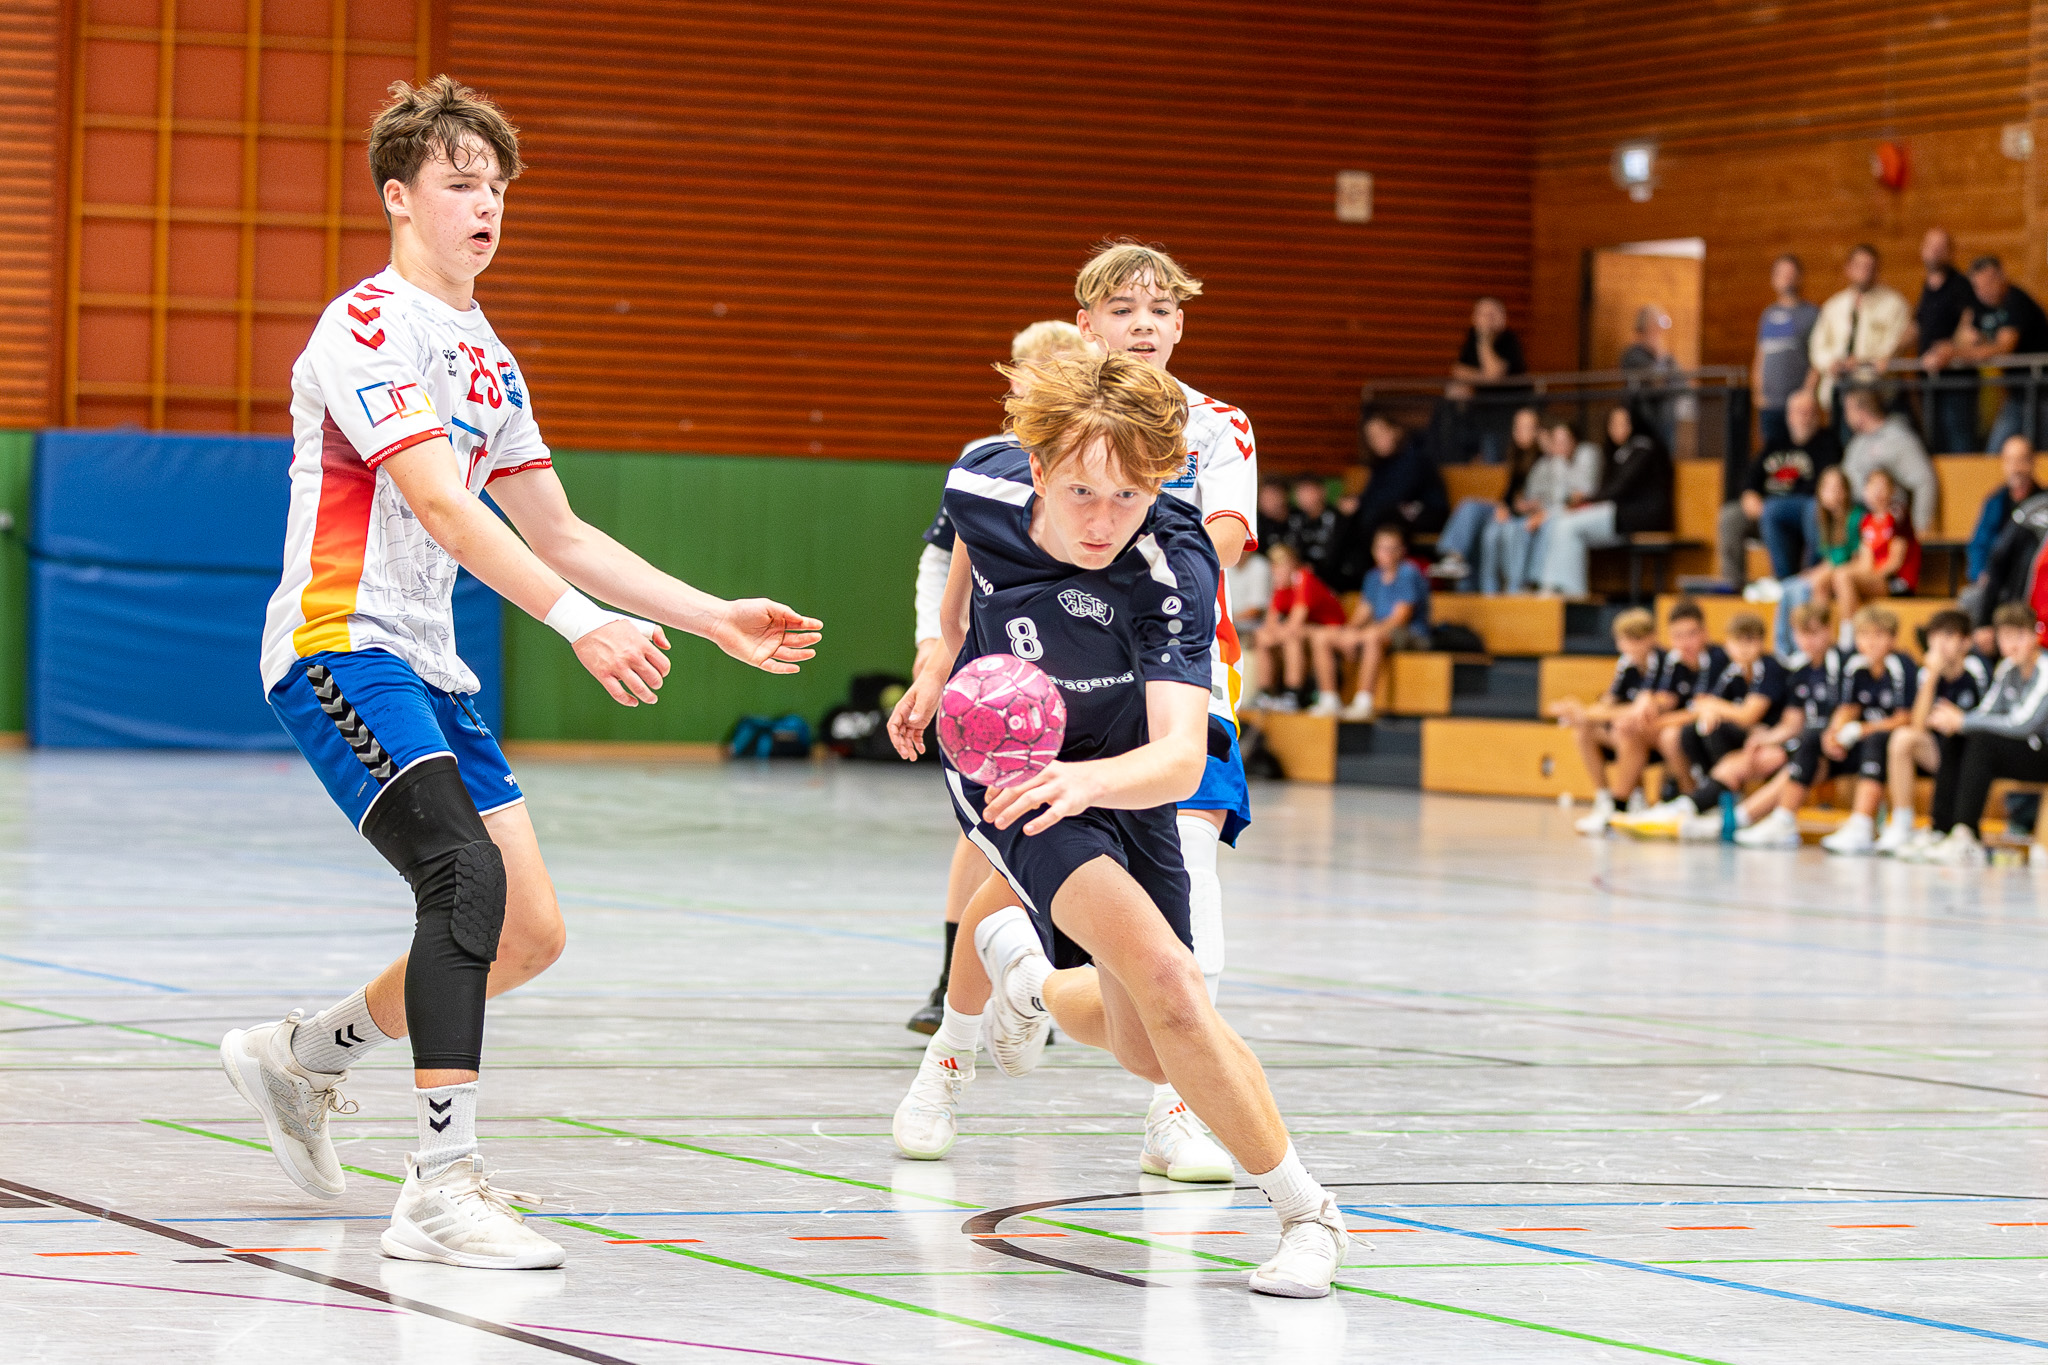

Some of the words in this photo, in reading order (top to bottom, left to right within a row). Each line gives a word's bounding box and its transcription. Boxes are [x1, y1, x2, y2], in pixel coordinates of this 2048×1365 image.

[458, 342, 503, 410] 25
[370, 443, 402, 464] Perspektiven
[1006, 617, 1044, 662] 8
